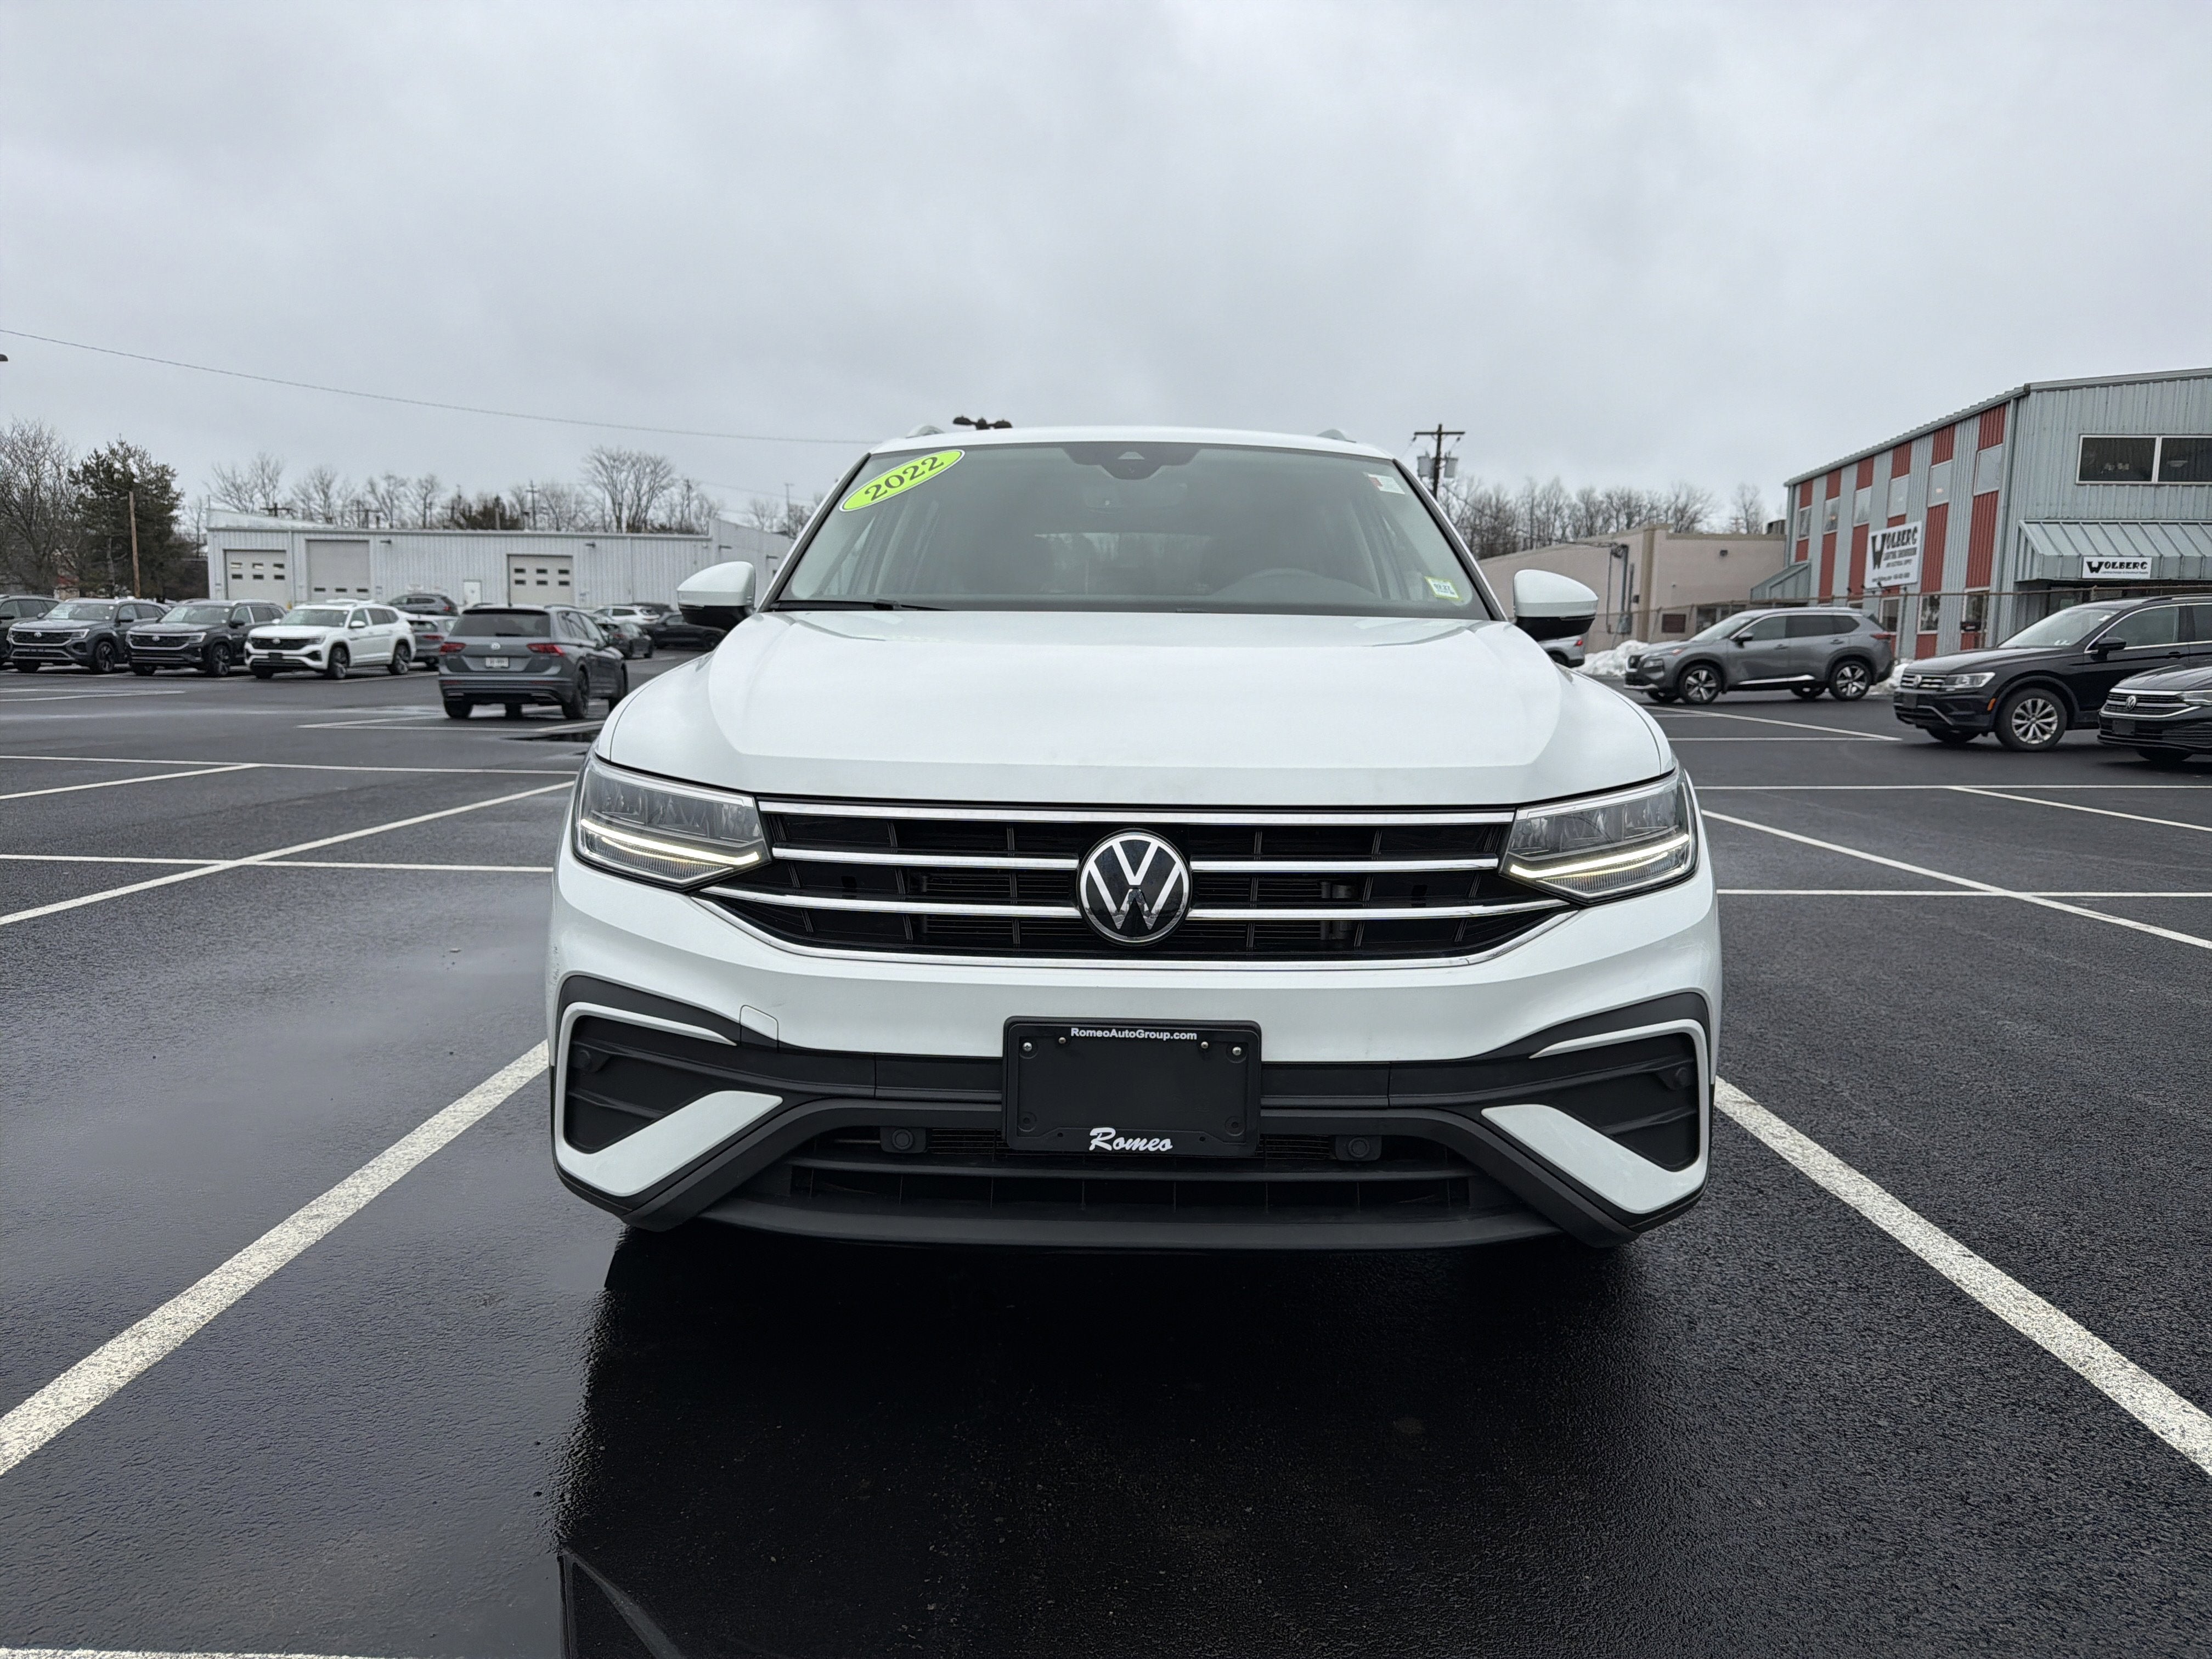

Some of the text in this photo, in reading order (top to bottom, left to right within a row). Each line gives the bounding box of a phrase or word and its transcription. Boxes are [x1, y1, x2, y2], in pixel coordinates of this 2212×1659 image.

[864, 456, 945, 501] 2022
[2086, 561, 2148, 573] WOLBERG
[1071, 1028, 1197, 1041] RomeoAutoGroup.com
[1089, 1127, 1173, 1152] Romeo
